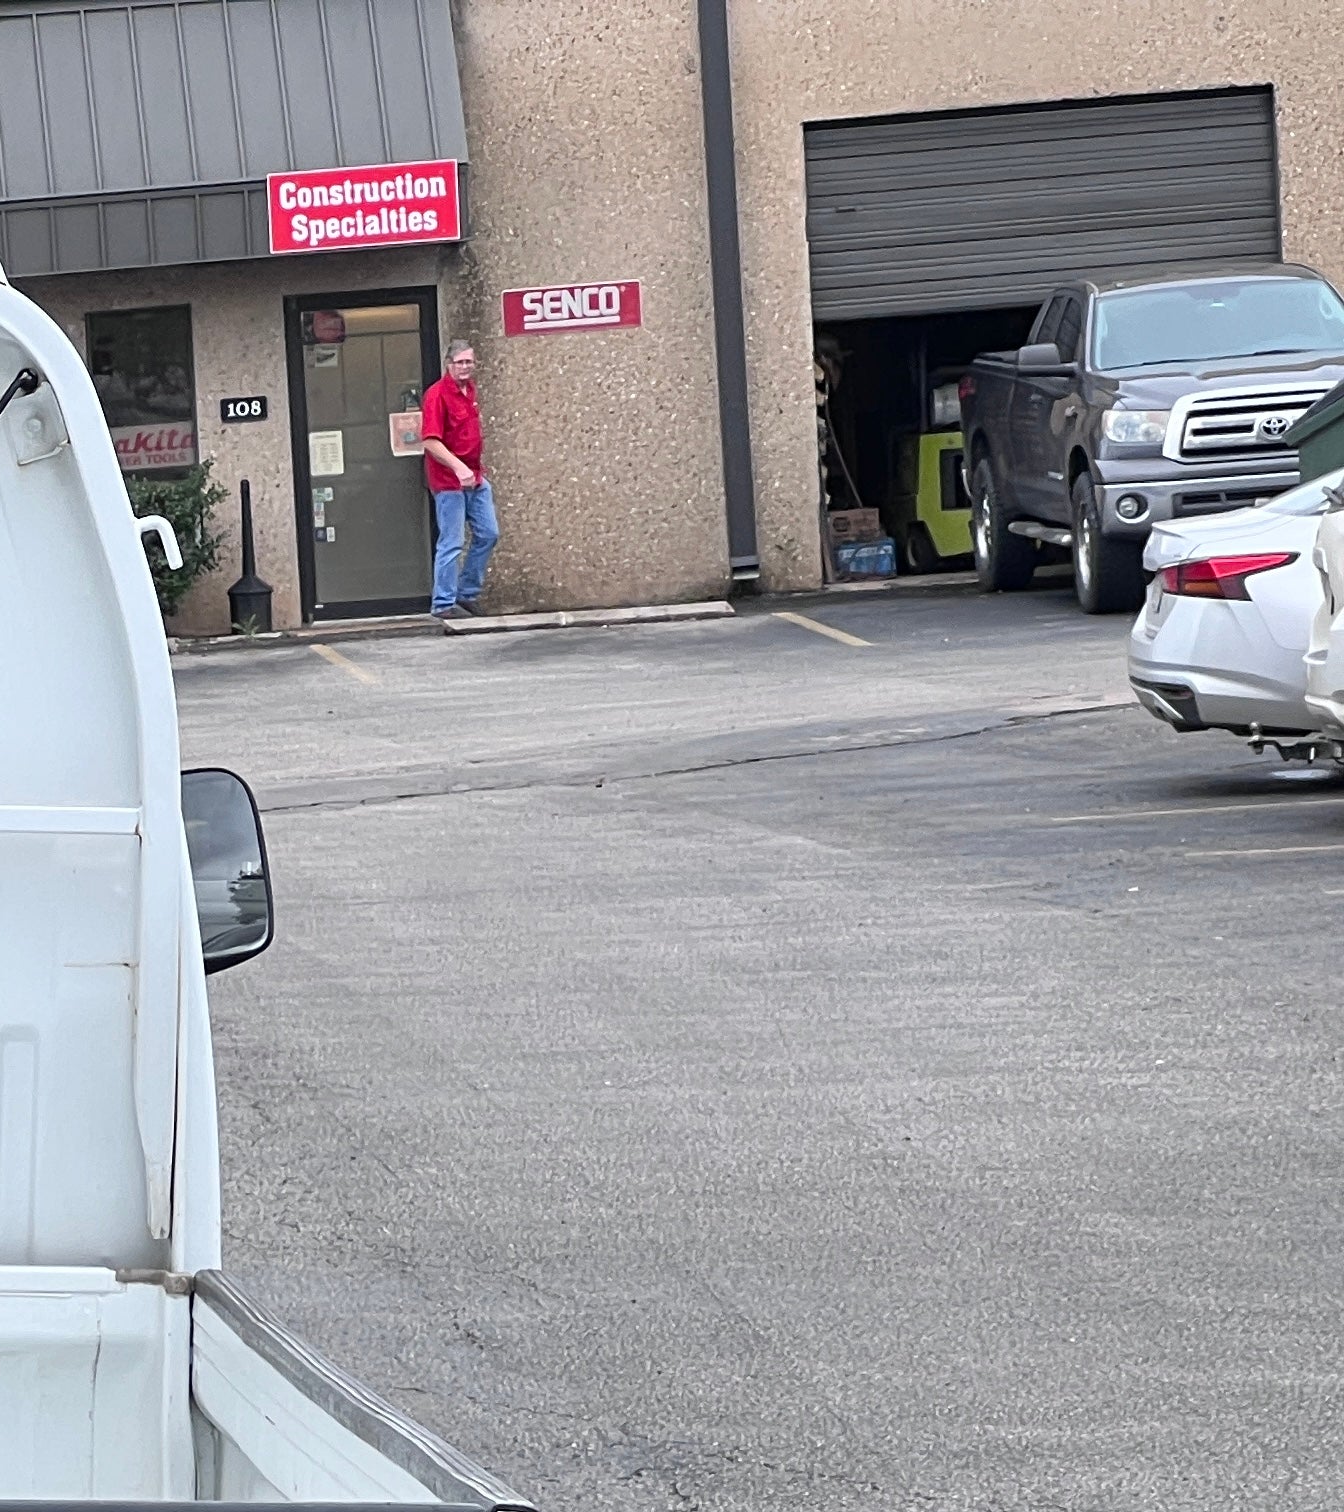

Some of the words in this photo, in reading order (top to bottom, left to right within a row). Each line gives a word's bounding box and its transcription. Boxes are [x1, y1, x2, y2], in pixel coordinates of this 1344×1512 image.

[279, 173, 447, 210] Construction
[291, 206, 438, 246] Specialties
[522, 286, 621, 322] SENCO
[227, 400, 262, 417] 108
[115, 428, 196, 454] akita
[146, 452, 187, 465] TOOLS
